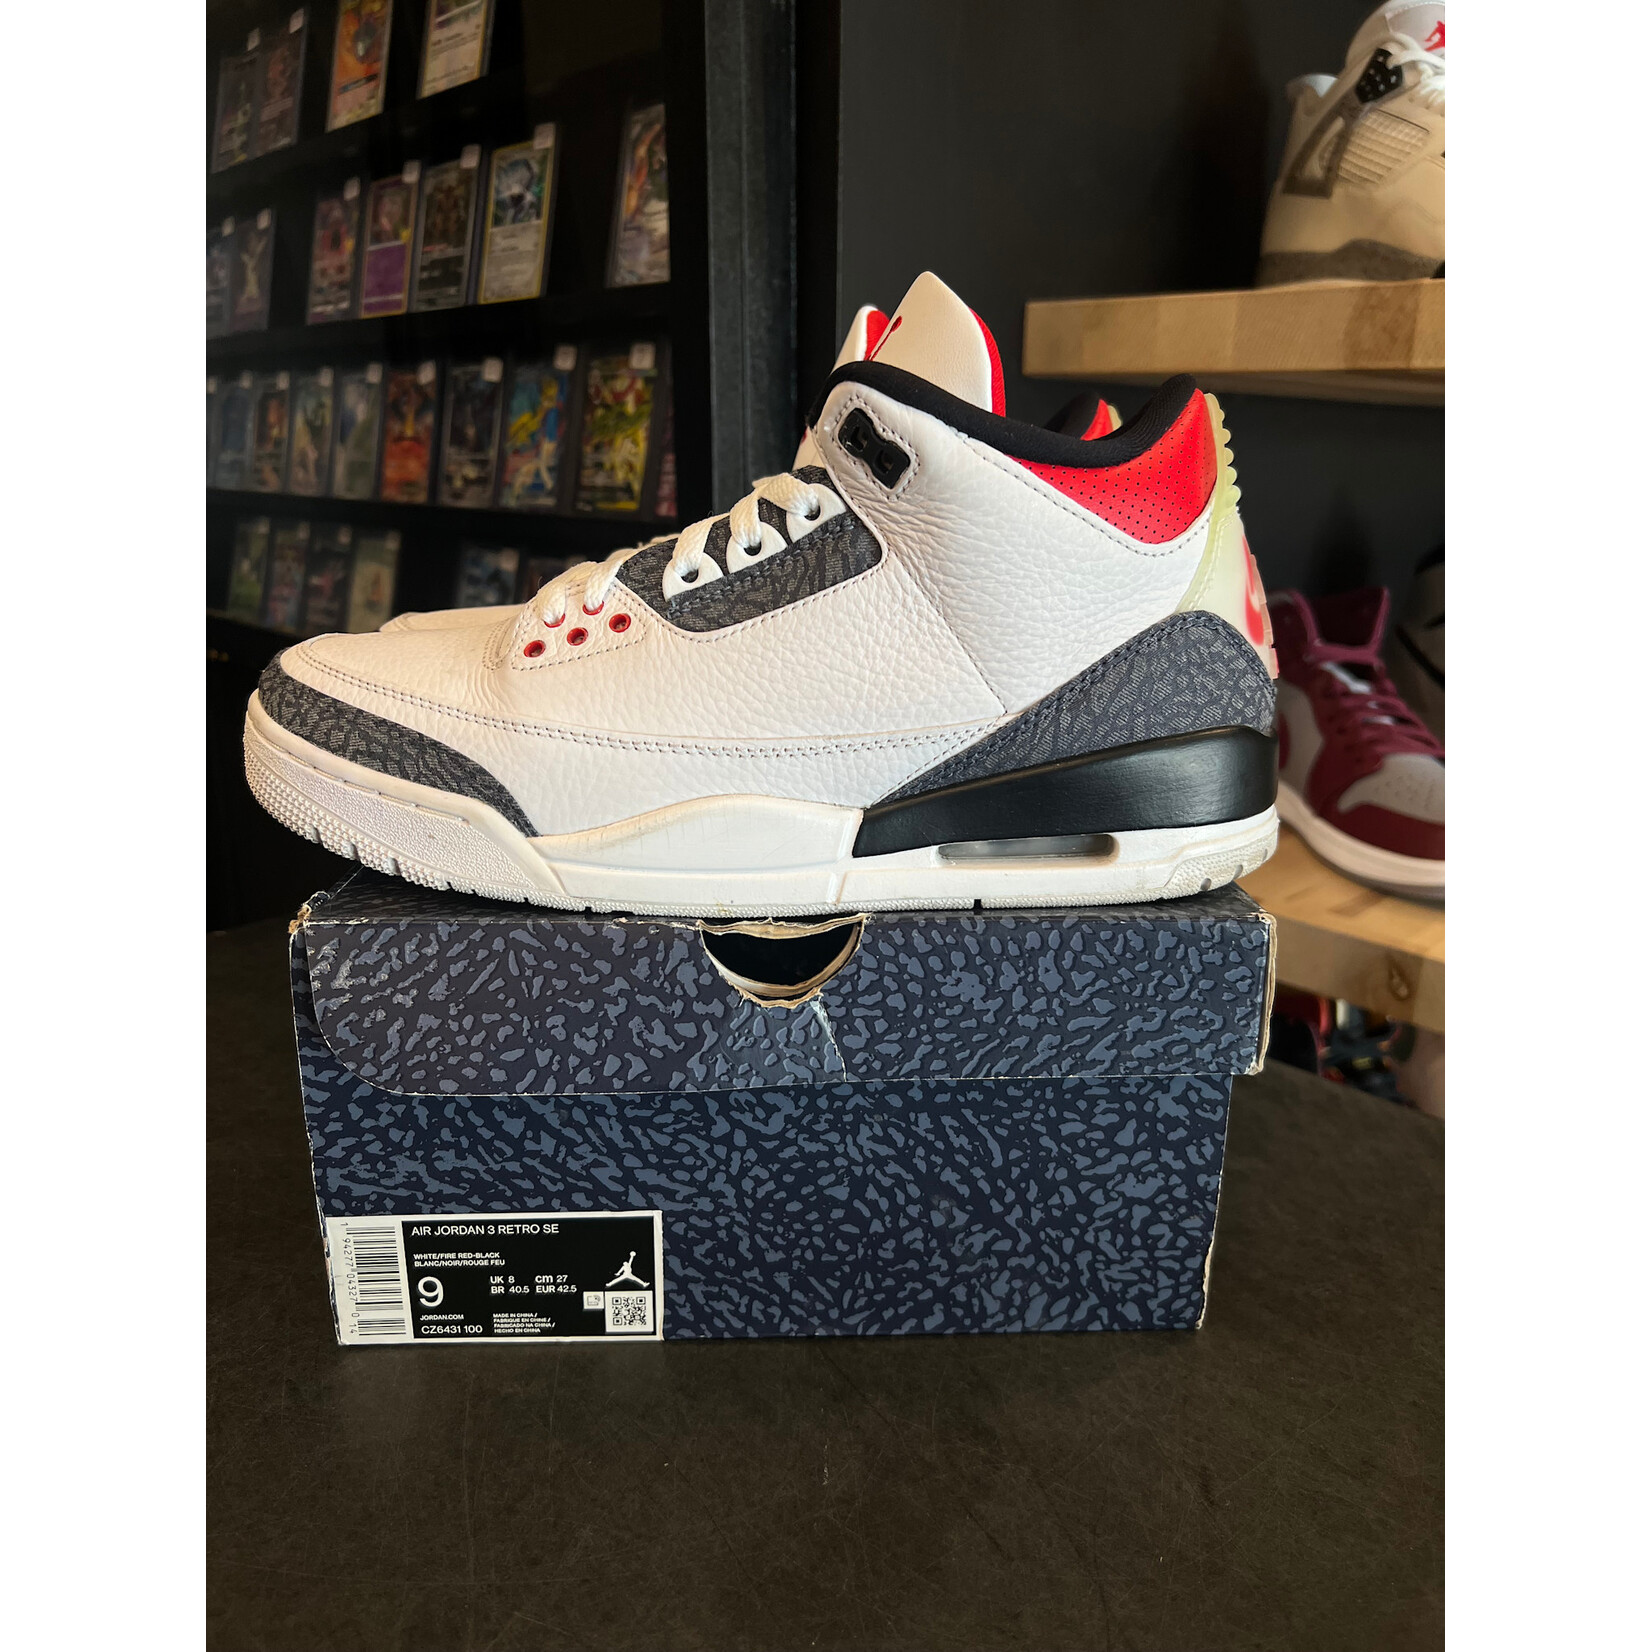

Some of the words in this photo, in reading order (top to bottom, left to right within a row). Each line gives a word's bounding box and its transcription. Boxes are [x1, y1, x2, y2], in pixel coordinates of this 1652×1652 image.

[411, 1226, 432, 1236] AIR
[434, 1225, 485, 1236] JORDAN
[487, 1225, 496, 1235] 3
[498, 1224, 540, 1235] RETRO
[543, 1223, 560, 1234] SE
[342, 1238, 354, 1267] 94277
[413, 1252, 457, 1260] WHITE/FIRE
[414, 1259, 490, 1267] BLANC/NOIR/ROUGE
[490, 1275, 504, 1284] UK
[508, 1275, 515, 1284] 8
[535, 1275, 554, 1283] cm
[556, 1274, 568, 1283] 27
[346, 1273, 358, 1302] 04327
[417, 1276, 444, 1307] 9
[490, 1285, 505, 1294] BR
[508, 1285, 530, 1293] 40.5
[535, 1285, 556, 1293] EUR
[556, 1284, 577, 1293] 42.5
[421, 1325, 461, 1334] CZ6431
[463, 1324, 483, 1334] 100
